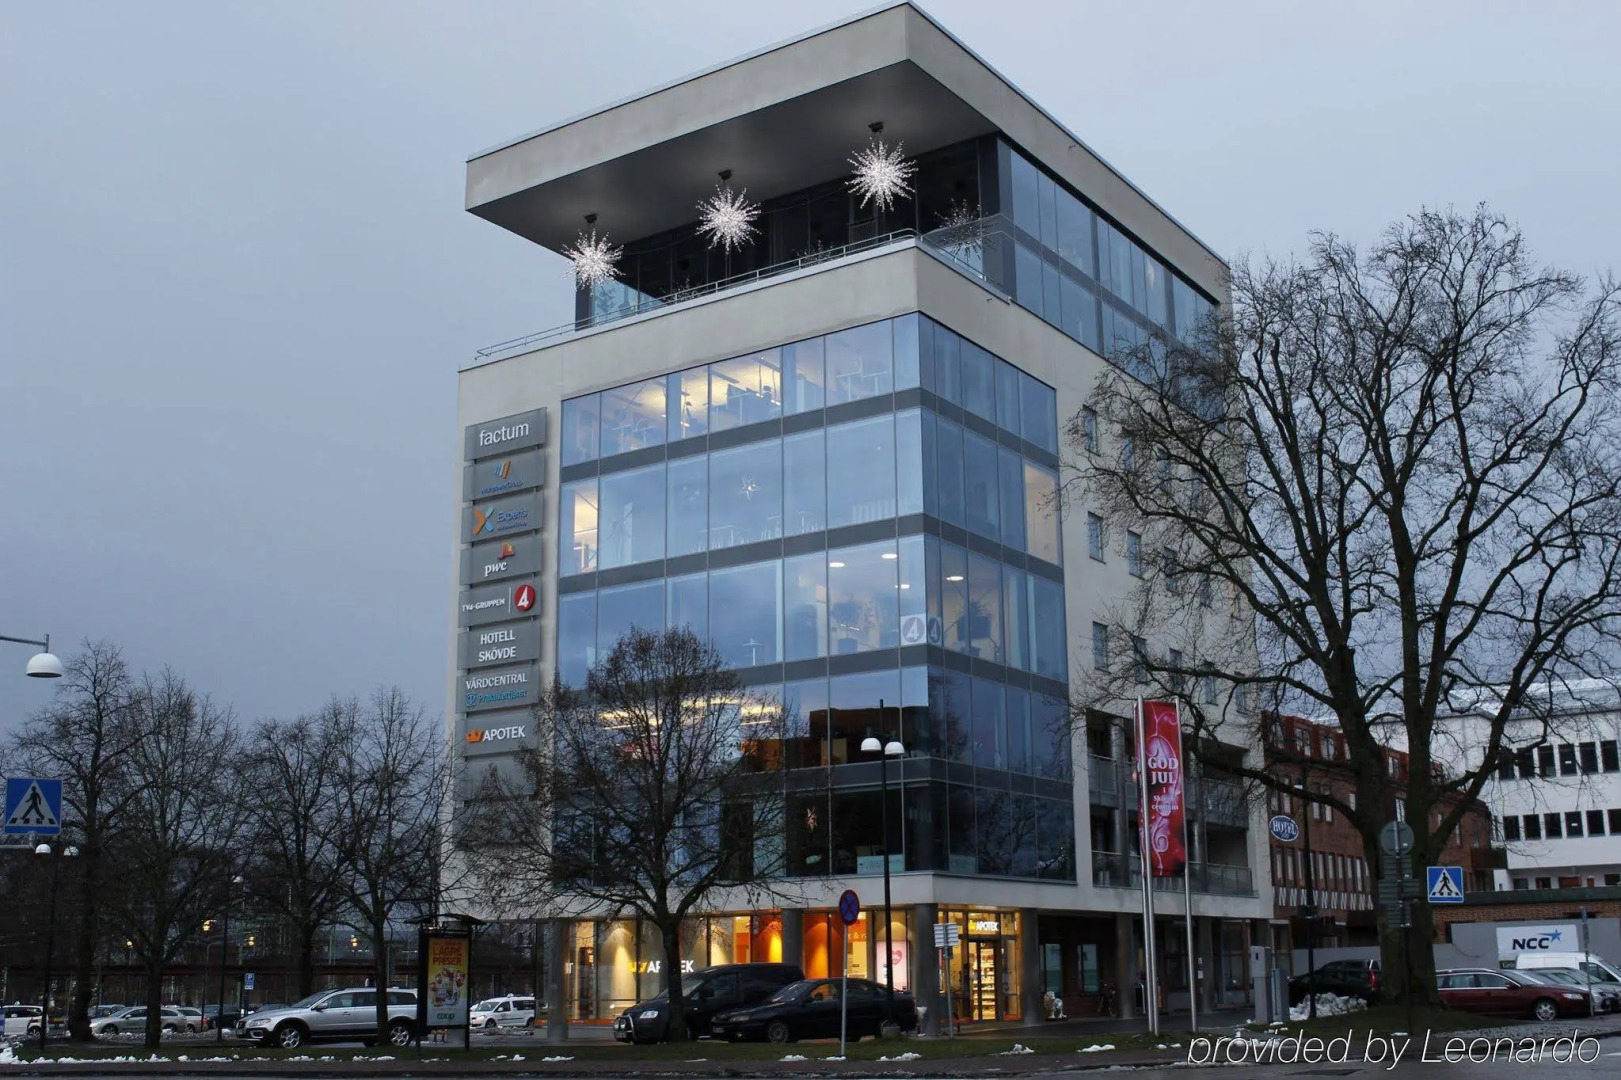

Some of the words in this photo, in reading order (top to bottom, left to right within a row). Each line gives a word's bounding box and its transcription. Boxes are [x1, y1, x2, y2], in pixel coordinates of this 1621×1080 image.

[479, 423, 529, 447] factum
[484, 561, 507, 577] pwc
[462, 598, 505, 612] TV4-GRUPPEN
[517, 585, 529, 608] 4
[480, 629, 516, 645] HOTELL
[906, 618, 920, 640] 4
[478, 646, 517, 662] SKÖVDE
[465, 672, 528, 690] VÅRDCENTRAL
[482, 725, 526, 742] APOTEK
[1147, 756, 1179, 769] GOD
[1151, 771, 1176, 785] JUL
[1272, 820, 1297, 835] HOTEL
[1512, 937, 1550, 951] NCC
[646, 960, 694, 973] APEK
